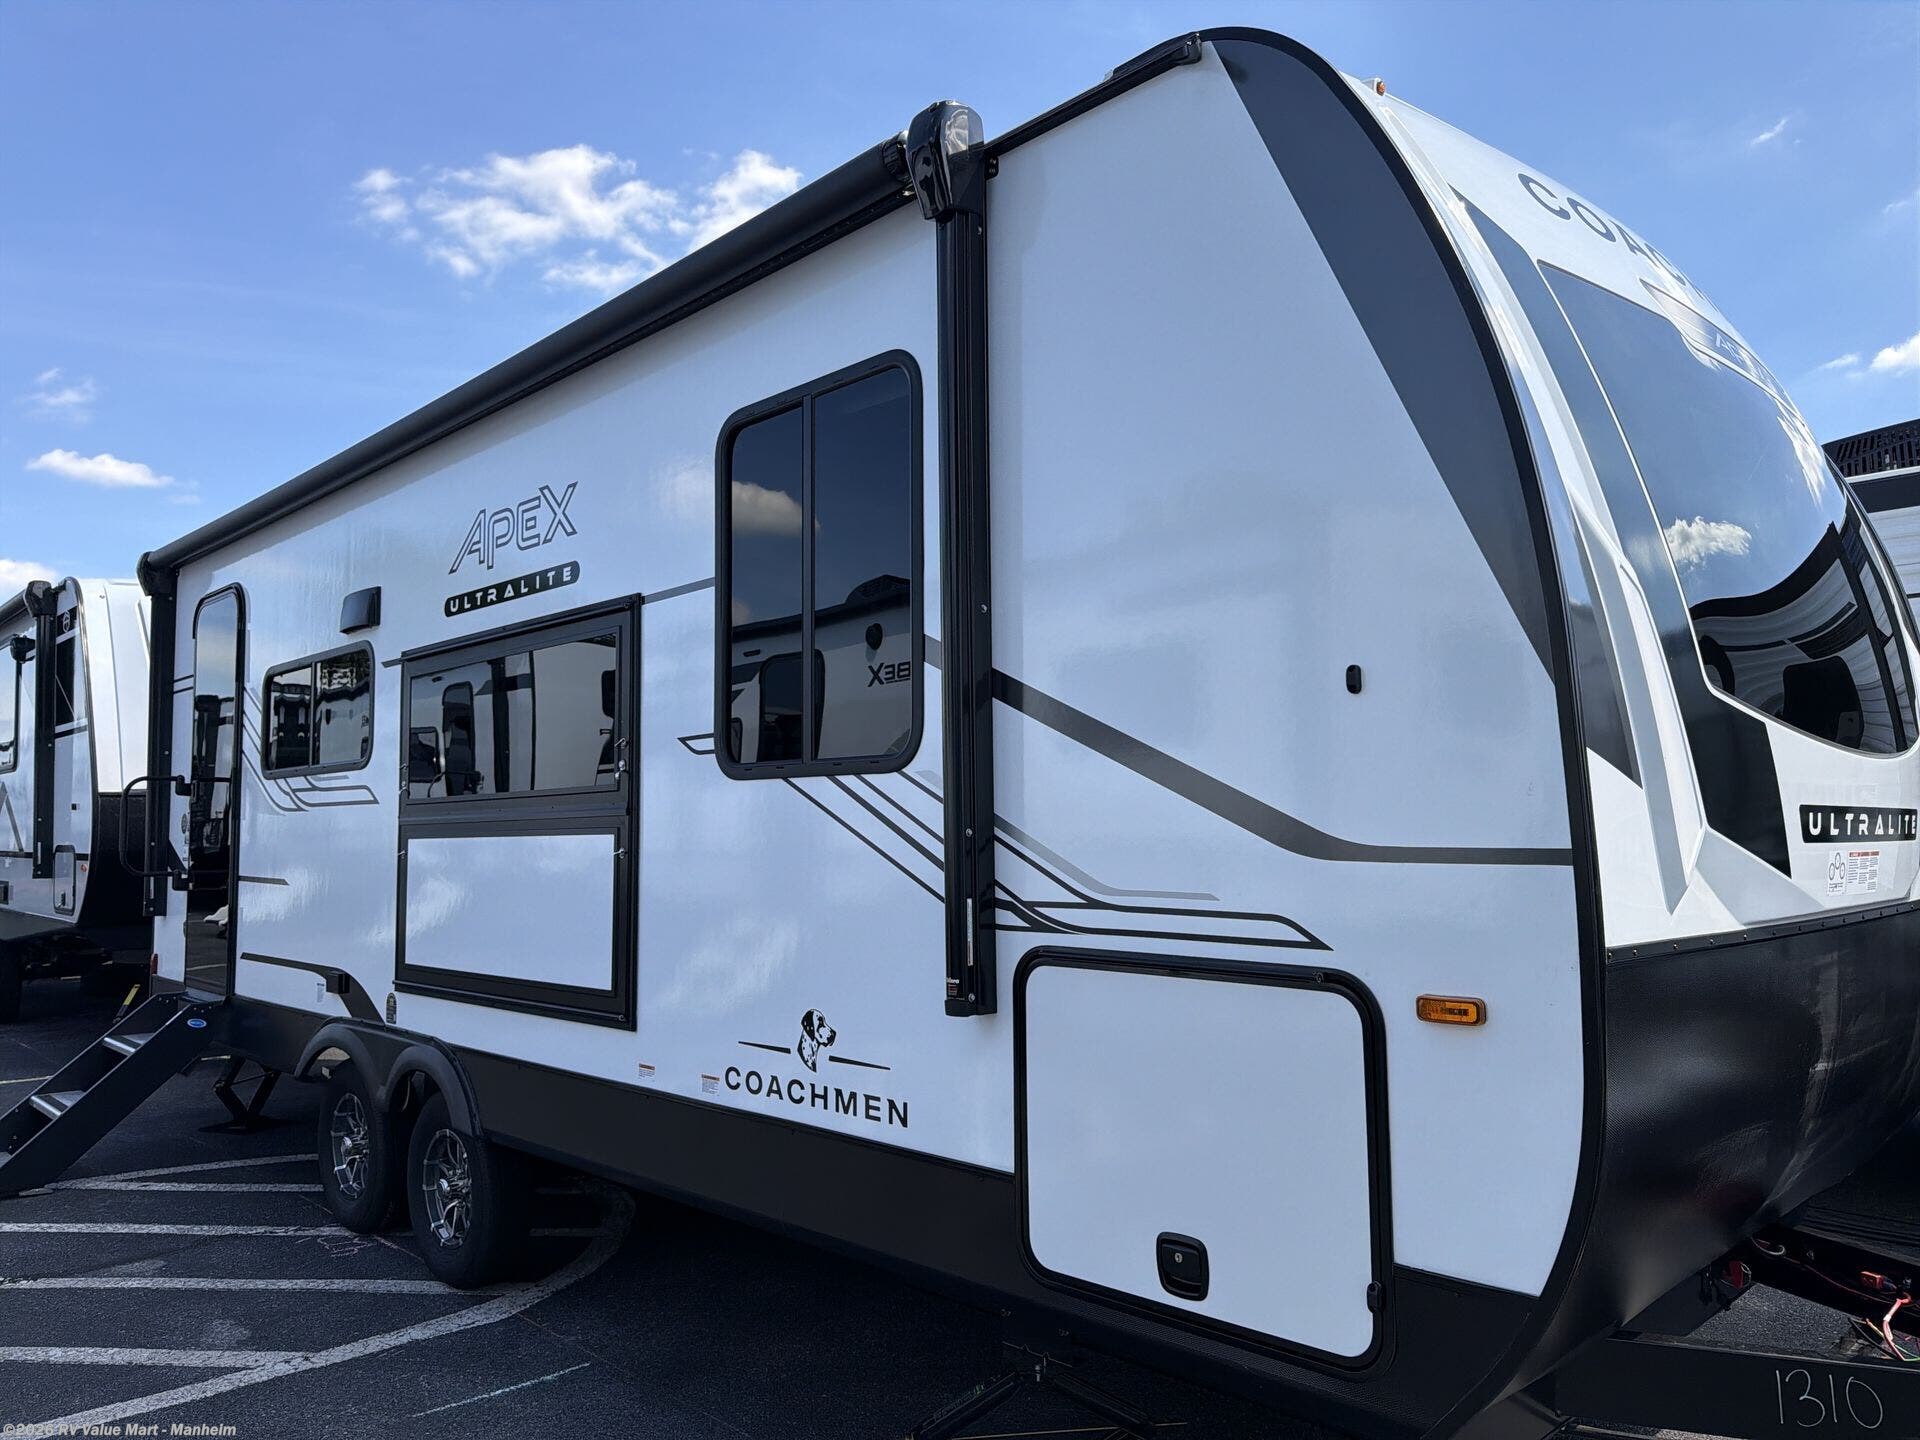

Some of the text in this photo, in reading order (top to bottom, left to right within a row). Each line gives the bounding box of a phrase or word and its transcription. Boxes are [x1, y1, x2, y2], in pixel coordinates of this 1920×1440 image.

[449, 481, 579, 575] APEX
[449, 565, 574, 614] ULTRALITE
[1808, 811, 1917, 836] ULTRALITE
[724, 1066, 909, 1128] COACHMEN
[1776, 1369, 1884, 1429] 1310
